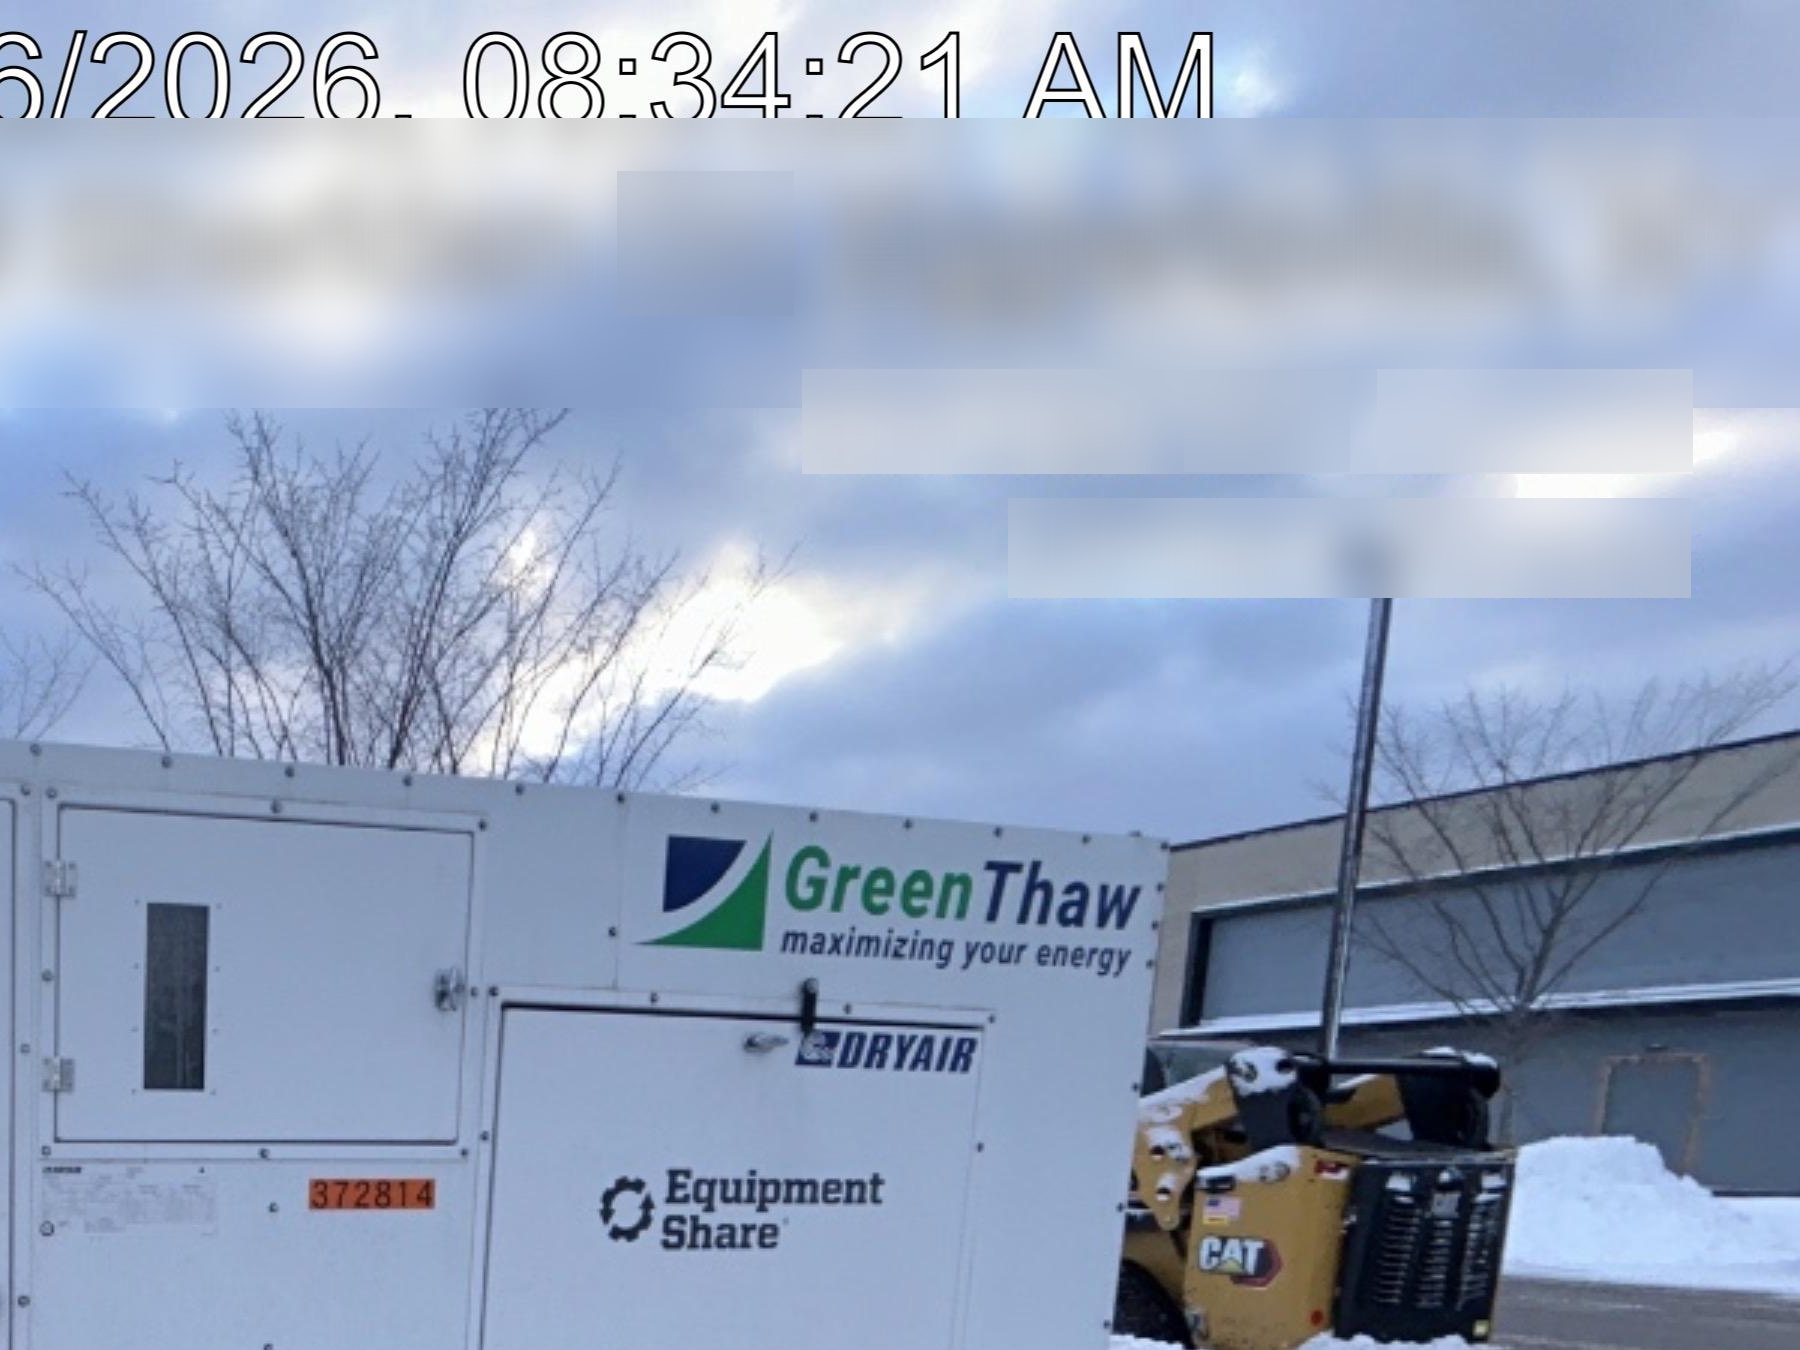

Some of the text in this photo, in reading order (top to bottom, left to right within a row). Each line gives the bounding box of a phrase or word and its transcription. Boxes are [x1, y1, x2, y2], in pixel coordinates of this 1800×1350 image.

[781, 926, 1132, 977] maximizing your energy
[836, 1030, 978, 1074] DRYAIR
[310, 1179, 434, 1209] 372814
[665, 1168, 885, 1213] Equipment
[660, 1214, 780, 1250] Share
[1200, 1236, 1265, 1275] CAT
